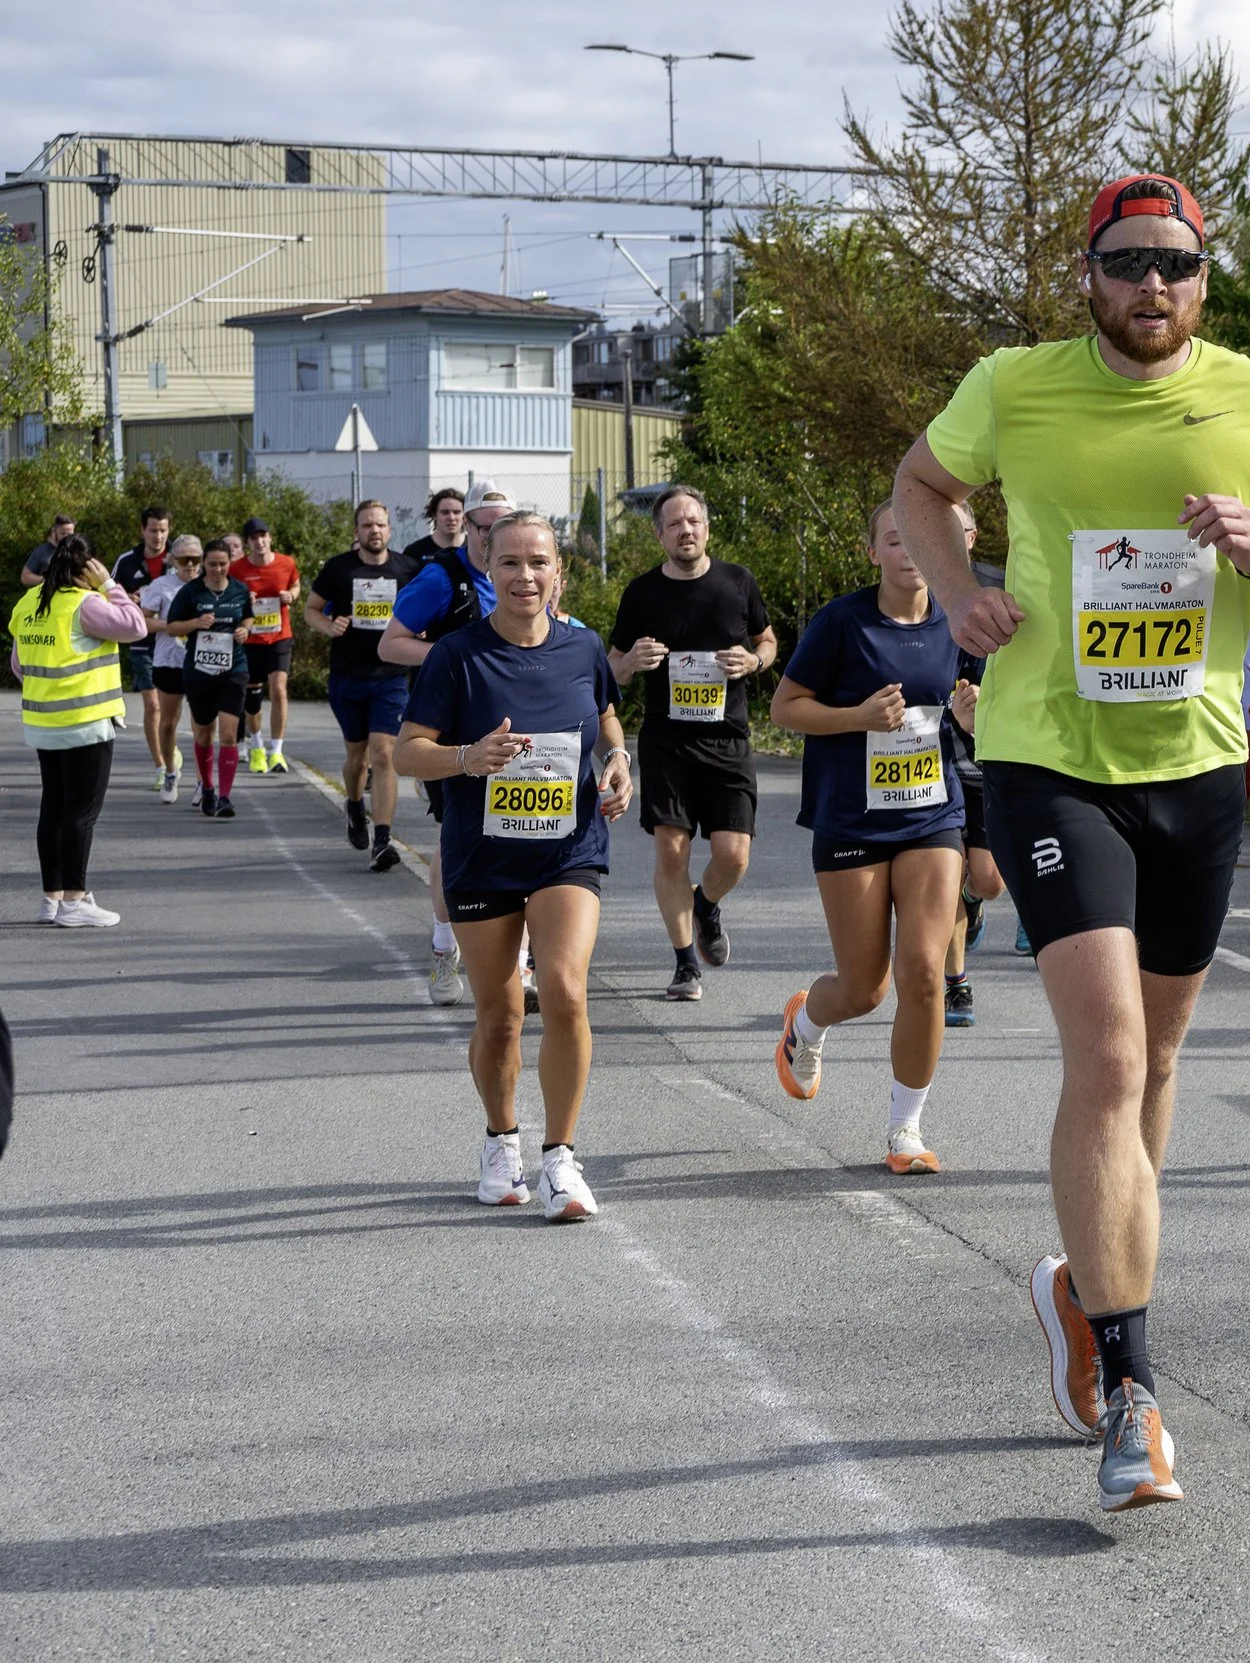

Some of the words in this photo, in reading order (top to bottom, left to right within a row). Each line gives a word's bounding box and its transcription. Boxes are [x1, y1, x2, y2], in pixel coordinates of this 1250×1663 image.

[1144, 551, 1196, 560] TRONDHEIM
[1144, 561, 1188, 570] MARATON
[1121, 582, 1160, 590] SpareBank
[356, 604, 388, 616] 28230
[1083, 602, 1134, 610] BRILLIANT
[1136, 600, 1204, 610] HALVMARATON
[1086, 618, 1192, 658] 27172
[1195, 616, 1204, 648] PULJE
[197, 652, 228, 665] 43242
[1098, 669, 1188, 690] BRILLIANT
[675, 687, 718, 704] 30139
[680, 708, 716, 716] BRILLIANT
[874, 756, 933, 783] 28142
[494, 786, 564, 812] 28096
[882, 786, 932, 802] BRILLIANT
[501, 818, 561, 831] BRILLIANT
[834, 850, 859, 858] CRAFT
